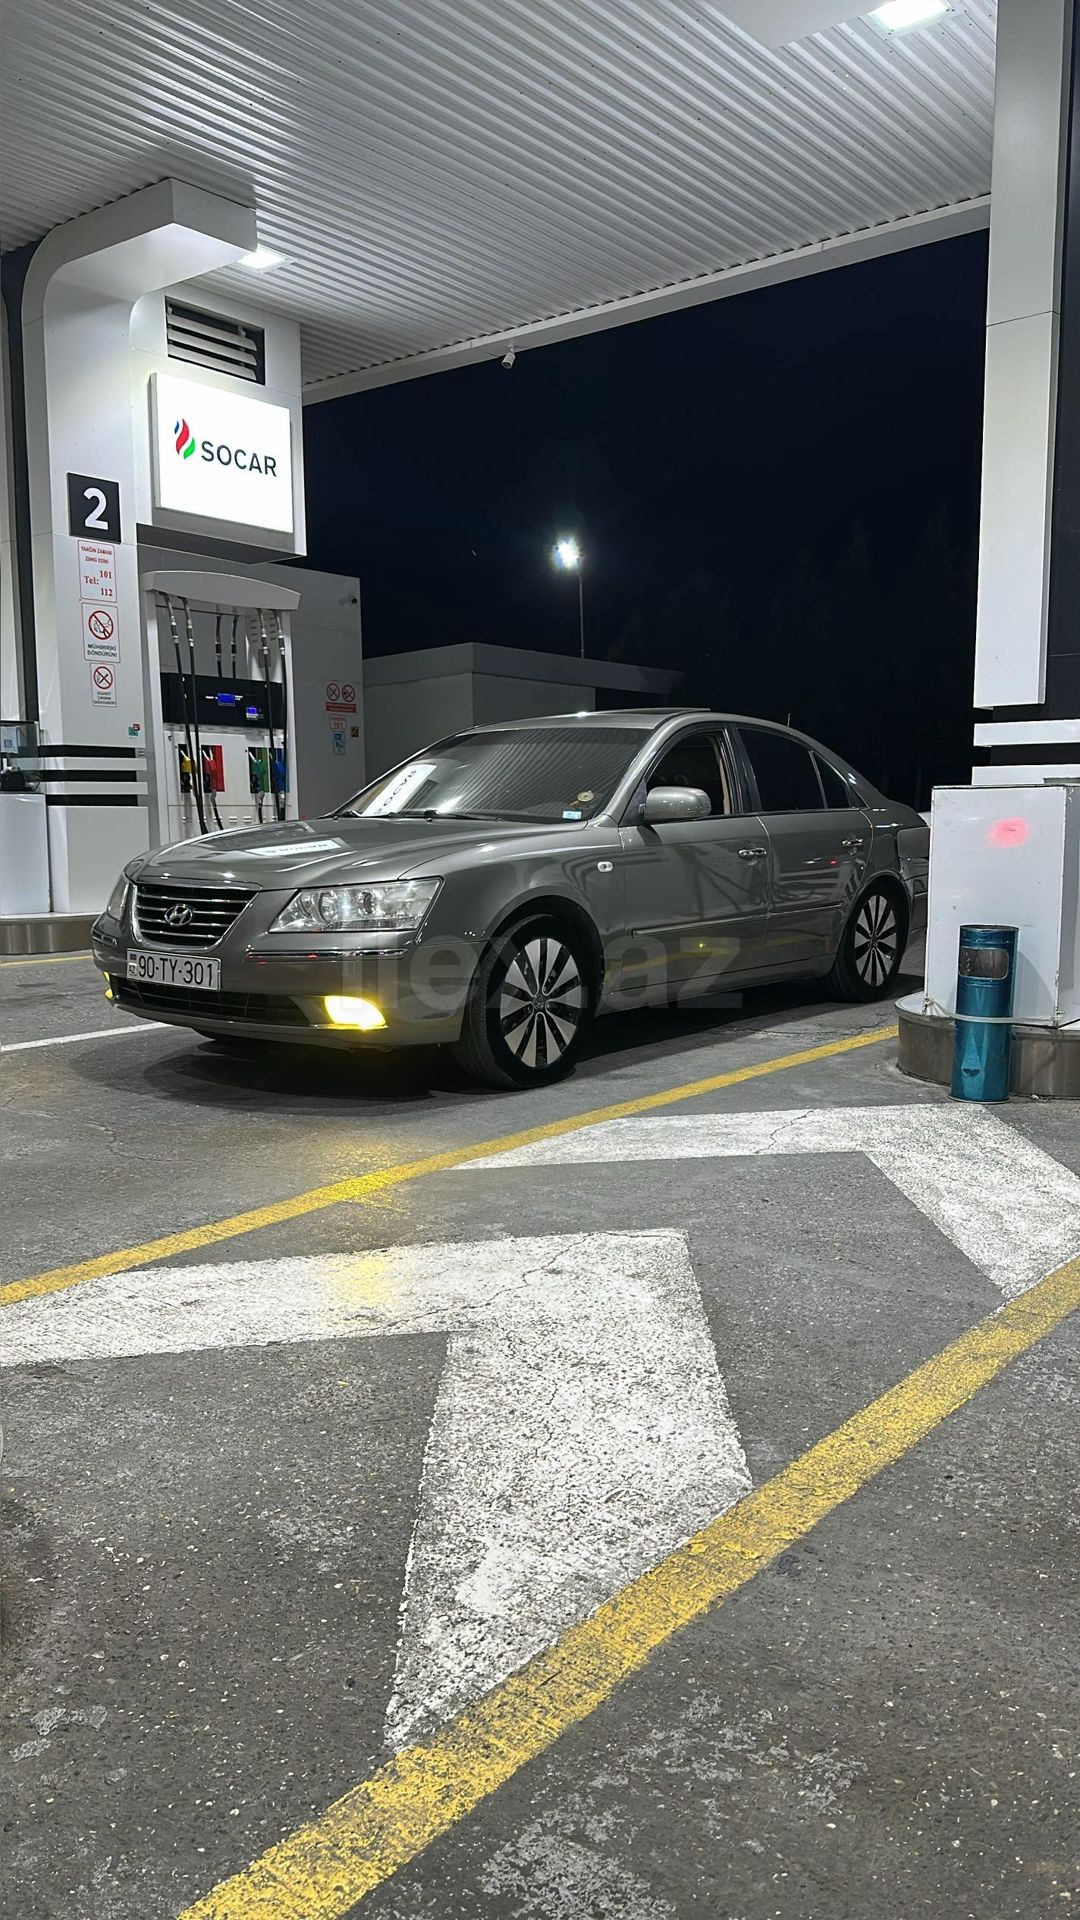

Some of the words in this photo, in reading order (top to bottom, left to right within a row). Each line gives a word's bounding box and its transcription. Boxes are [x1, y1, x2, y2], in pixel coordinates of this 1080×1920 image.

[201, 440, 277, 477] SOCAR
[83, 487, 107, 530] 2
[84, 575, 99, 585] Tel:
[100, 570, 112, 579] 101
[101, 588, 113, 597] 112
[139, 956, 213, 987] 90-TY-301
